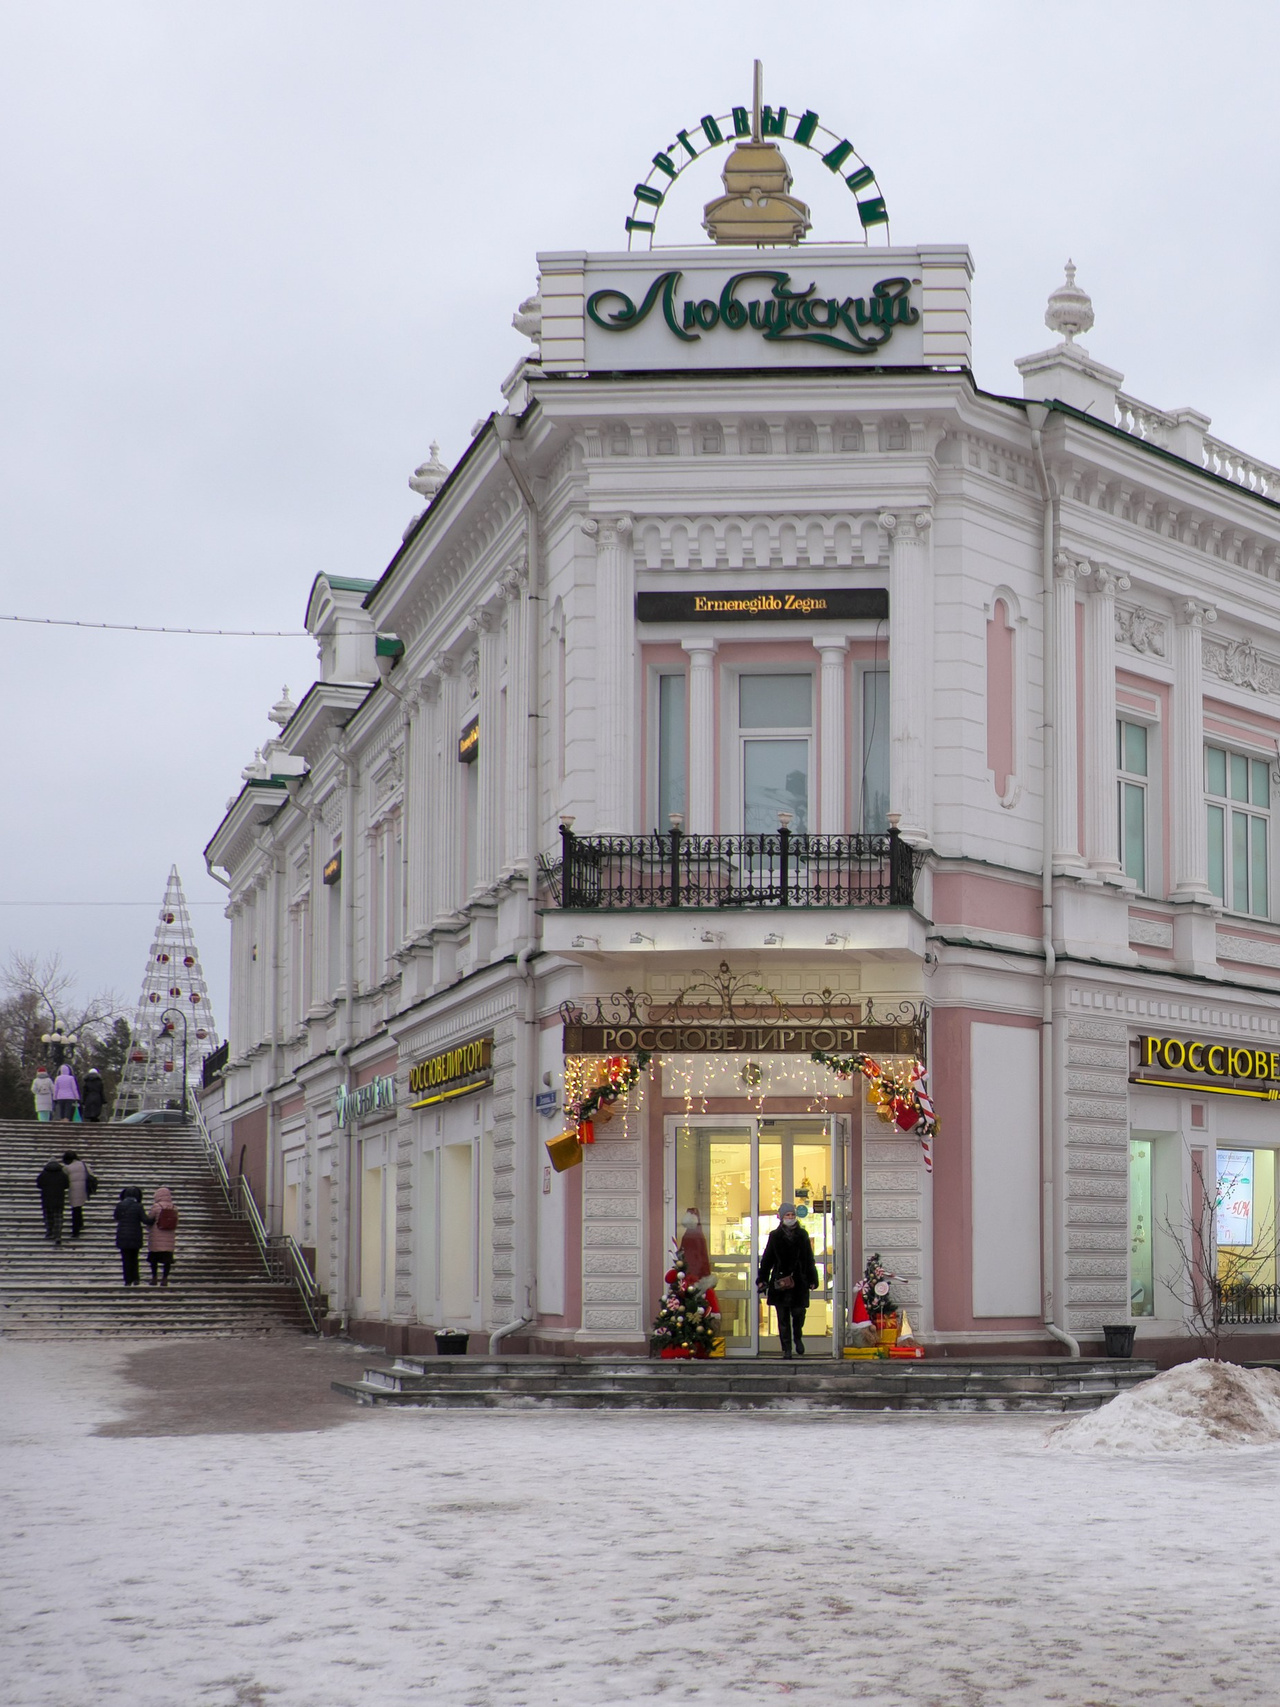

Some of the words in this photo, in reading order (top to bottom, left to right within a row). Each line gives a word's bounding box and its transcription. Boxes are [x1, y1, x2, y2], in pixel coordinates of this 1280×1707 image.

[625, 105, 820, 234] ТОРГОВЫЙ
[821, 138, 890, 229] ДОМ
[586, 271, 921, 354] Любинский
[694, 595, 782, 614] Ermenegildo
[784, 594, 828, 614] Zegna
[603, 1028, 867, 1051] РОССЮВЕЛИРТОРГ
